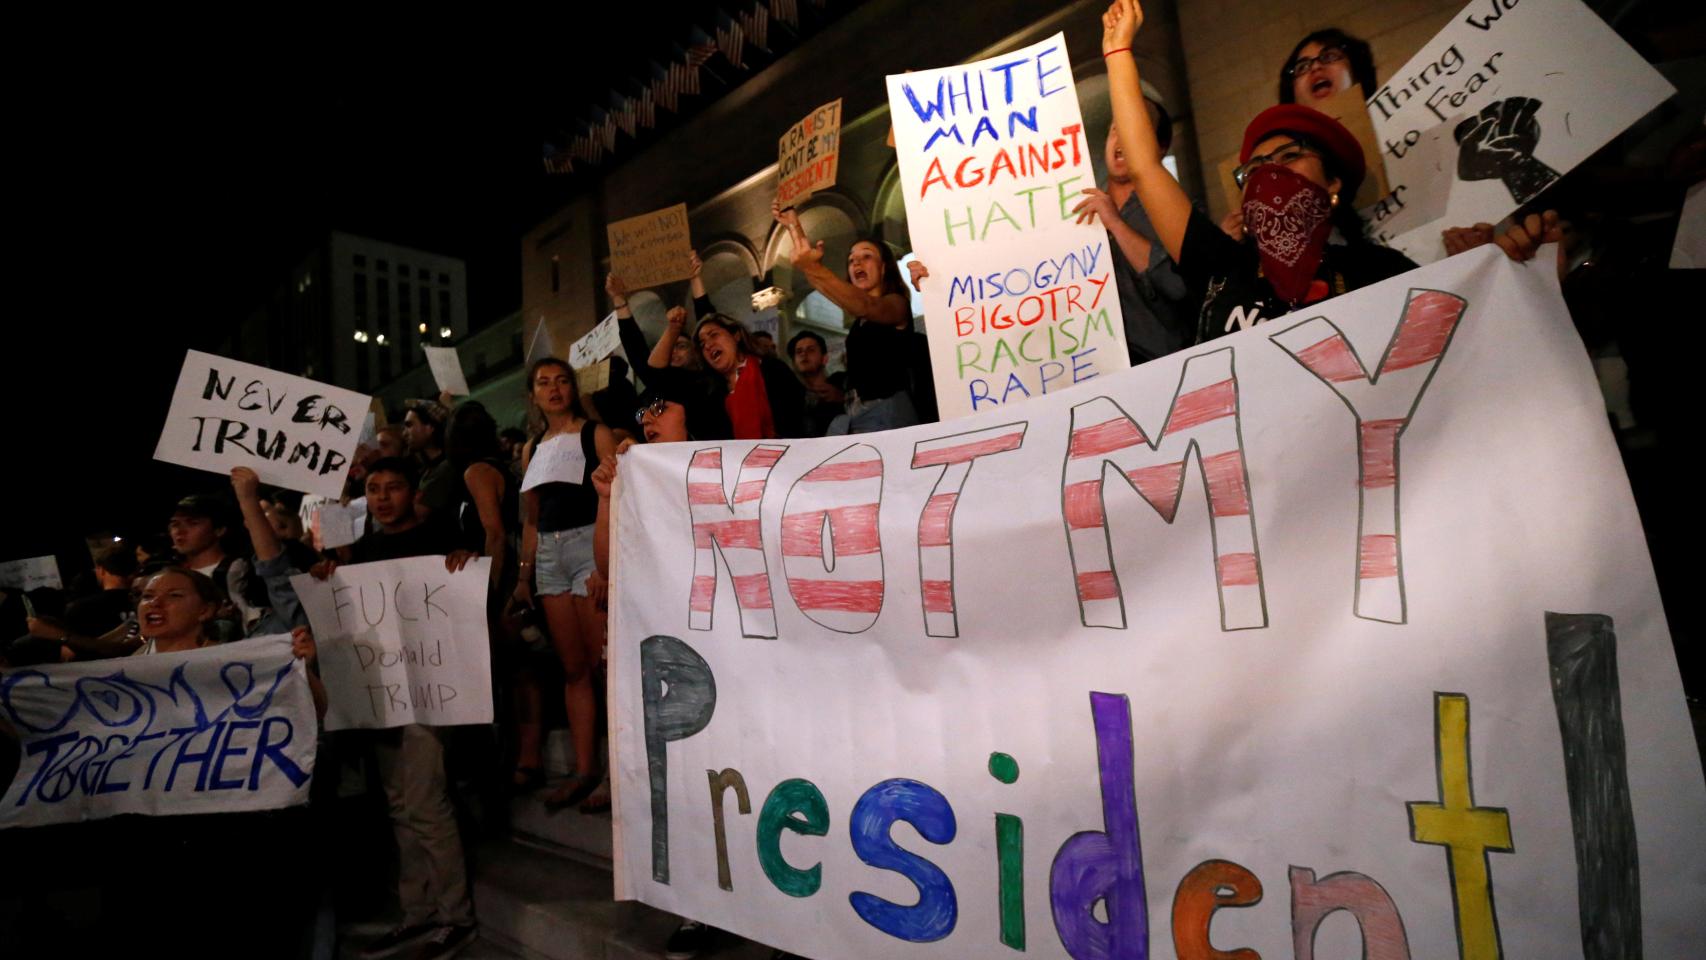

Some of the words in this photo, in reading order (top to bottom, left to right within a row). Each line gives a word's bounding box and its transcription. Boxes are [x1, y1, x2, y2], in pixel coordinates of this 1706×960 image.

[901, 46, 1067, 123] WHITE
[1368, 43, 1465, 122] Thing
[1386, 128, 1422, 159] to
[1425, 50, 1504, 123] Fear
[920, 124, 1082, 202] AGAINST
[923, 106, 1039, 152] MAN
[943, 175, 1085, 246] HATE
[948, 243, 1103, 307] MISOGYNY
[954, 273, 1110, 337] BIGOTRY
[956, 307, 1117, 380] RACISM
[201, 367, 352, 435] NEVER
[968, 347, 1100, 411] RAPE
[189, 416, 347, 476] TRUMP
[686, 420, 1029, 640] NOT
[1061, 287, 1469, 632] MY
[331, 581, 449, 630] FUCK
[353, 639, 443, 672] Donald
[361, 683, 458, 721] TRUMP
[15, 716, 311, 807] TOGETHER
